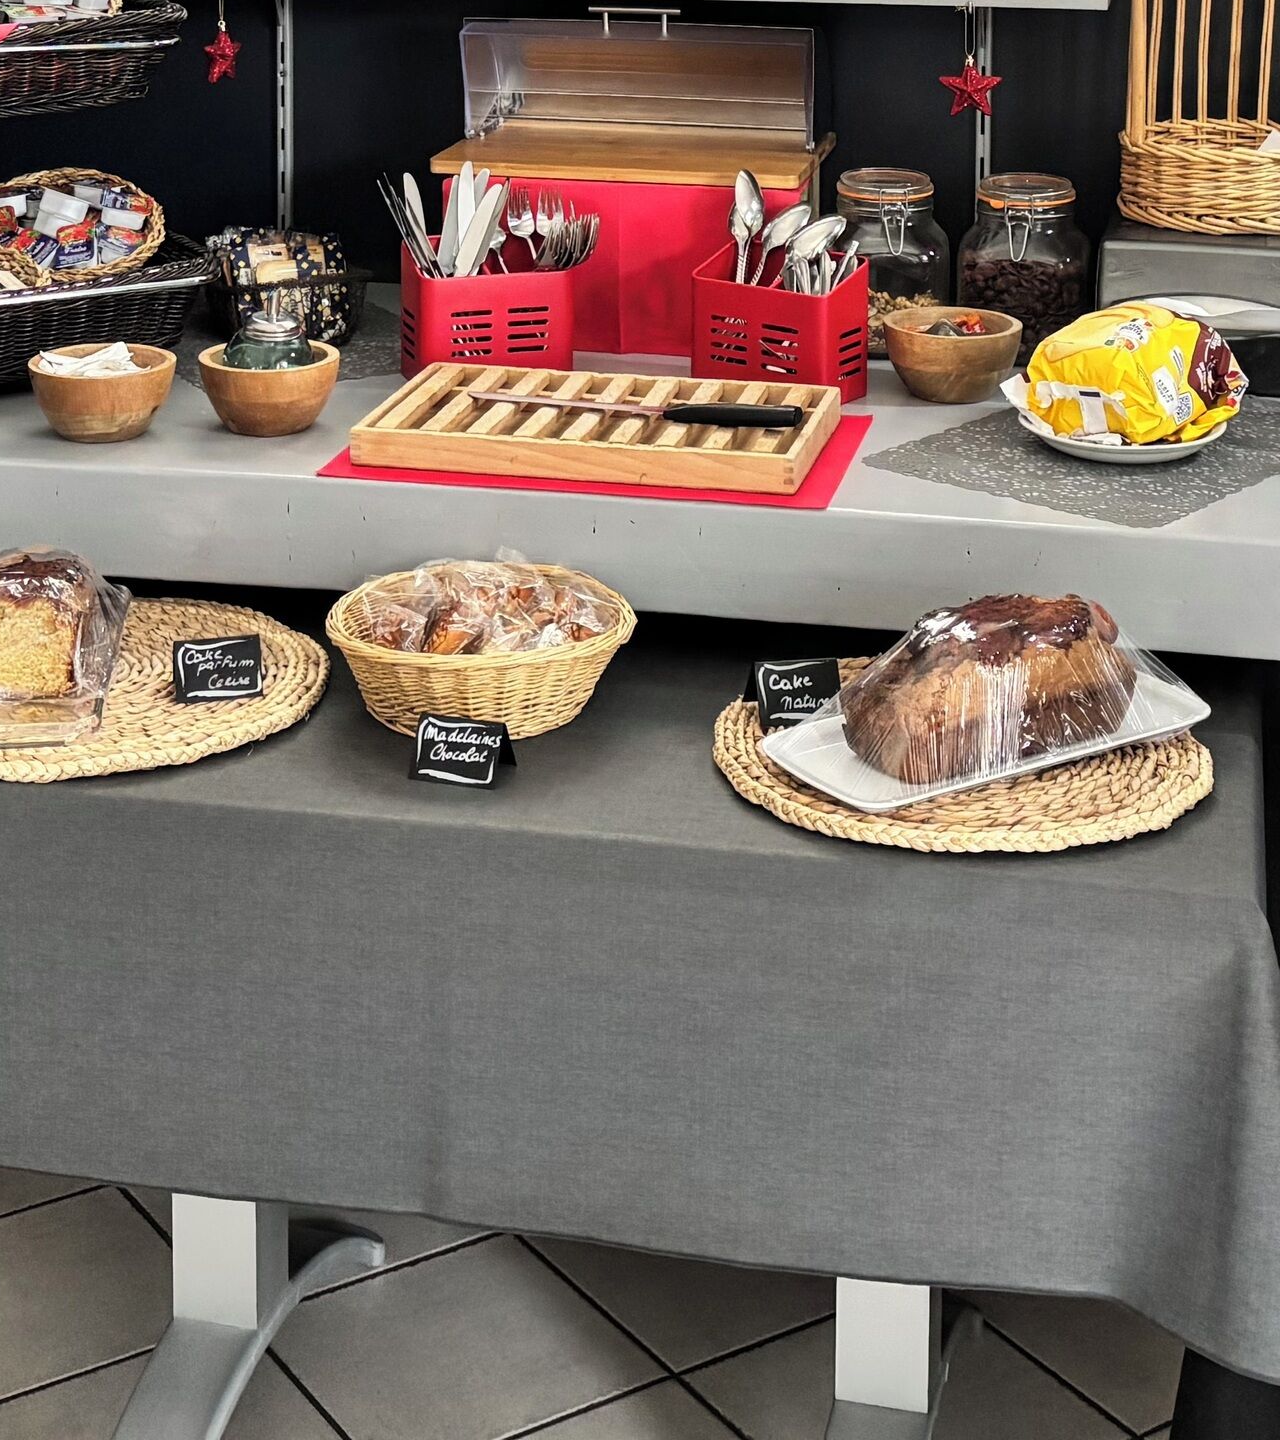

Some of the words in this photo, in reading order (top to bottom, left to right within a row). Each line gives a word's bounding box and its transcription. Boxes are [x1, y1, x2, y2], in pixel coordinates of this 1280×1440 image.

[185, 649, 223, 664] Cake
[197, 655, 254, 677] parfum
[768, 673, 813, 690] Cake
[424, 724, 503, 748] Madelaines
[430, 742, 488, 763] Chocolat
